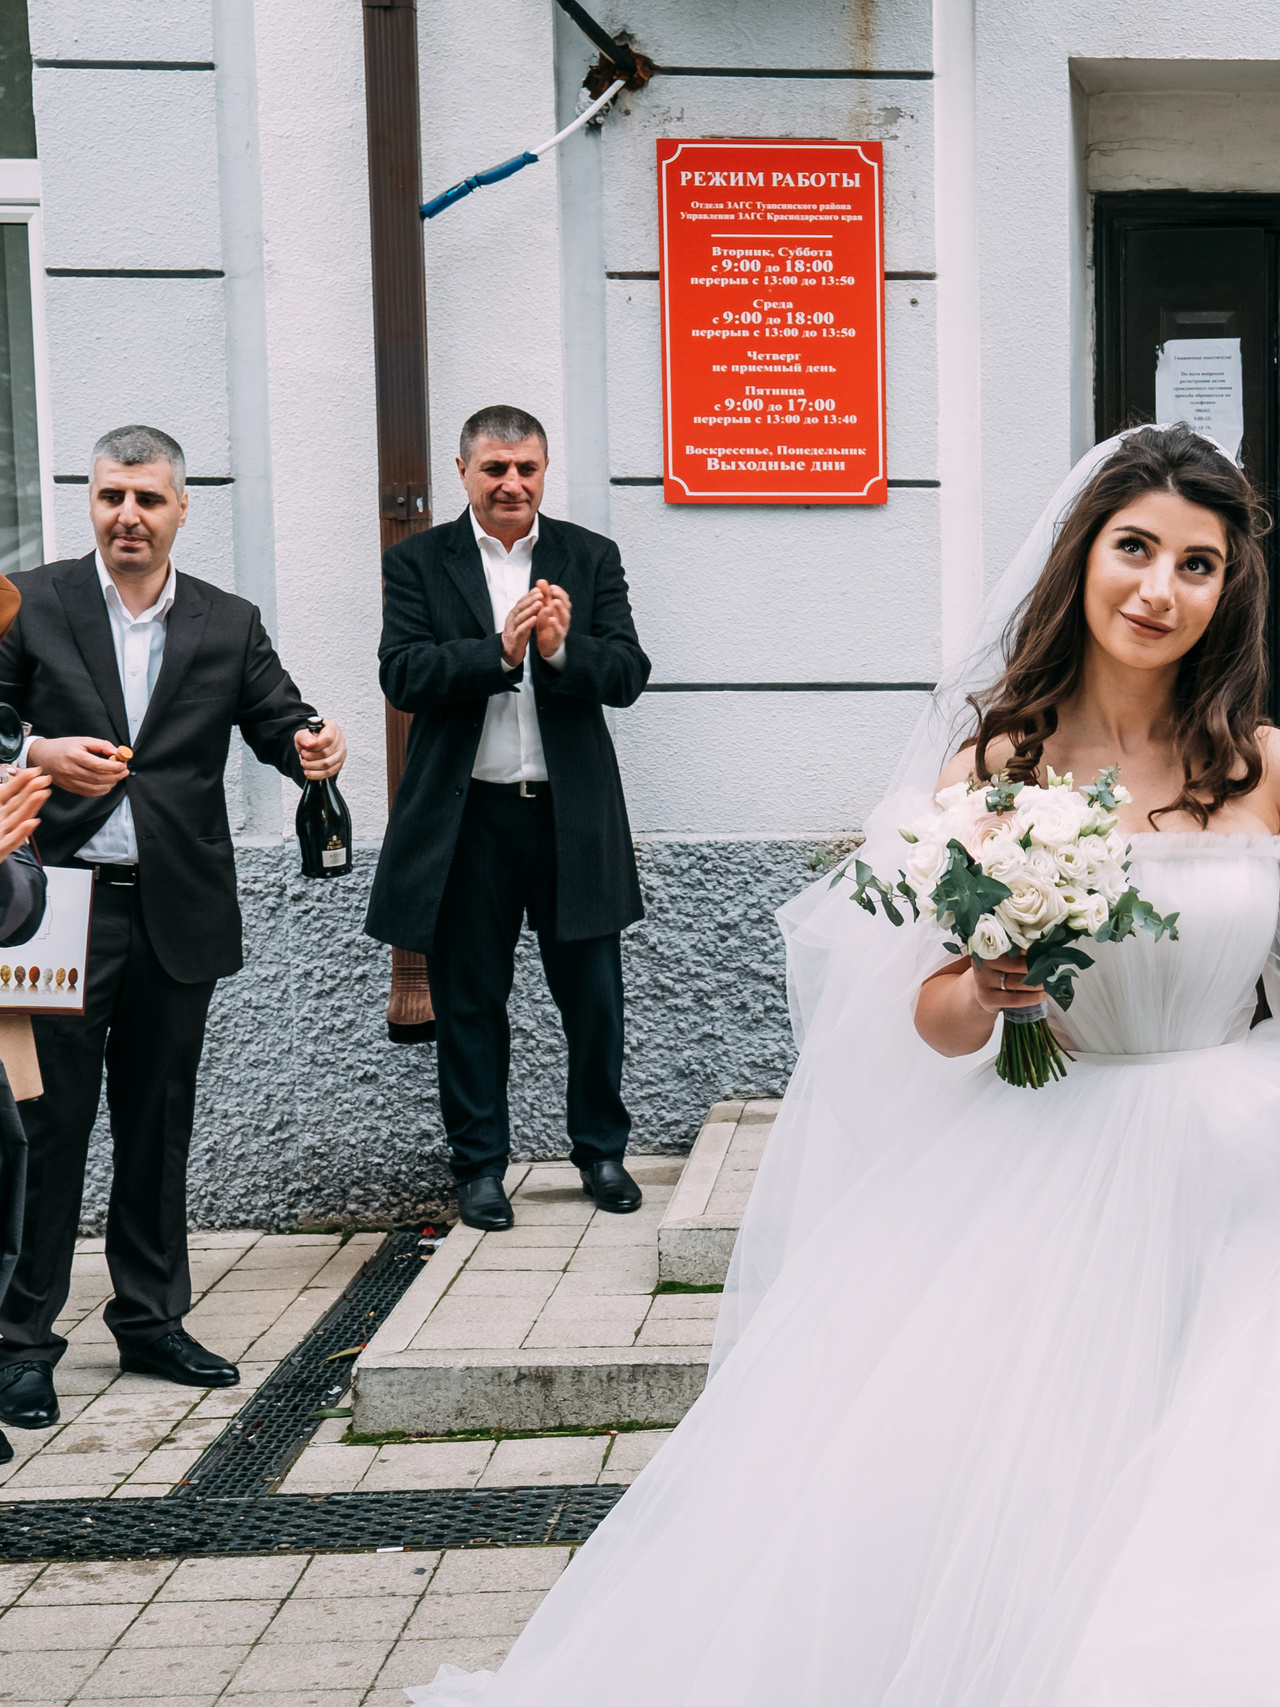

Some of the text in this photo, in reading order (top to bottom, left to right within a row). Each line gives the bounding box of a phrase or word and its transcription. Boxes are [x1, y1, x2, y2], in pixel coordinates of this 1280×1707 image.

[681, 171, 860, 187] РЕЖИМ РАБОТЫ
[691, 201, 851, 211] Отдела ЗАГС Туапсинского района
[680, 212, 863, 222] Управления ЗАГС Краснодарского края
[712, 247, 832, 259] Вторник, Суббота
[711, 259, 833, 273] с 9:00 до 18:00
[691, 276, 855, 287] перерыв с 13:00 до 13:50
[753, 299, 793, 311] Среда
[712, 311, 834, 325] с 9:00 до 18:00
[692, 328, 856, 339] перерыв с 13:00 до 13:50
[747, 351, 801, 363] Четверг
[712, 363, 836, 374] не приемный день
[745, 386, 805, 396] Пятница
[714, 398, 836, 412] с 9:00 до 17:00
[694, 414, 857, 426] перерыв с 13:00 до 13:40
[685, 445, 866, 457] Воскресенье, Понедельник
[707, 458, 845, 472] Выходные дни
